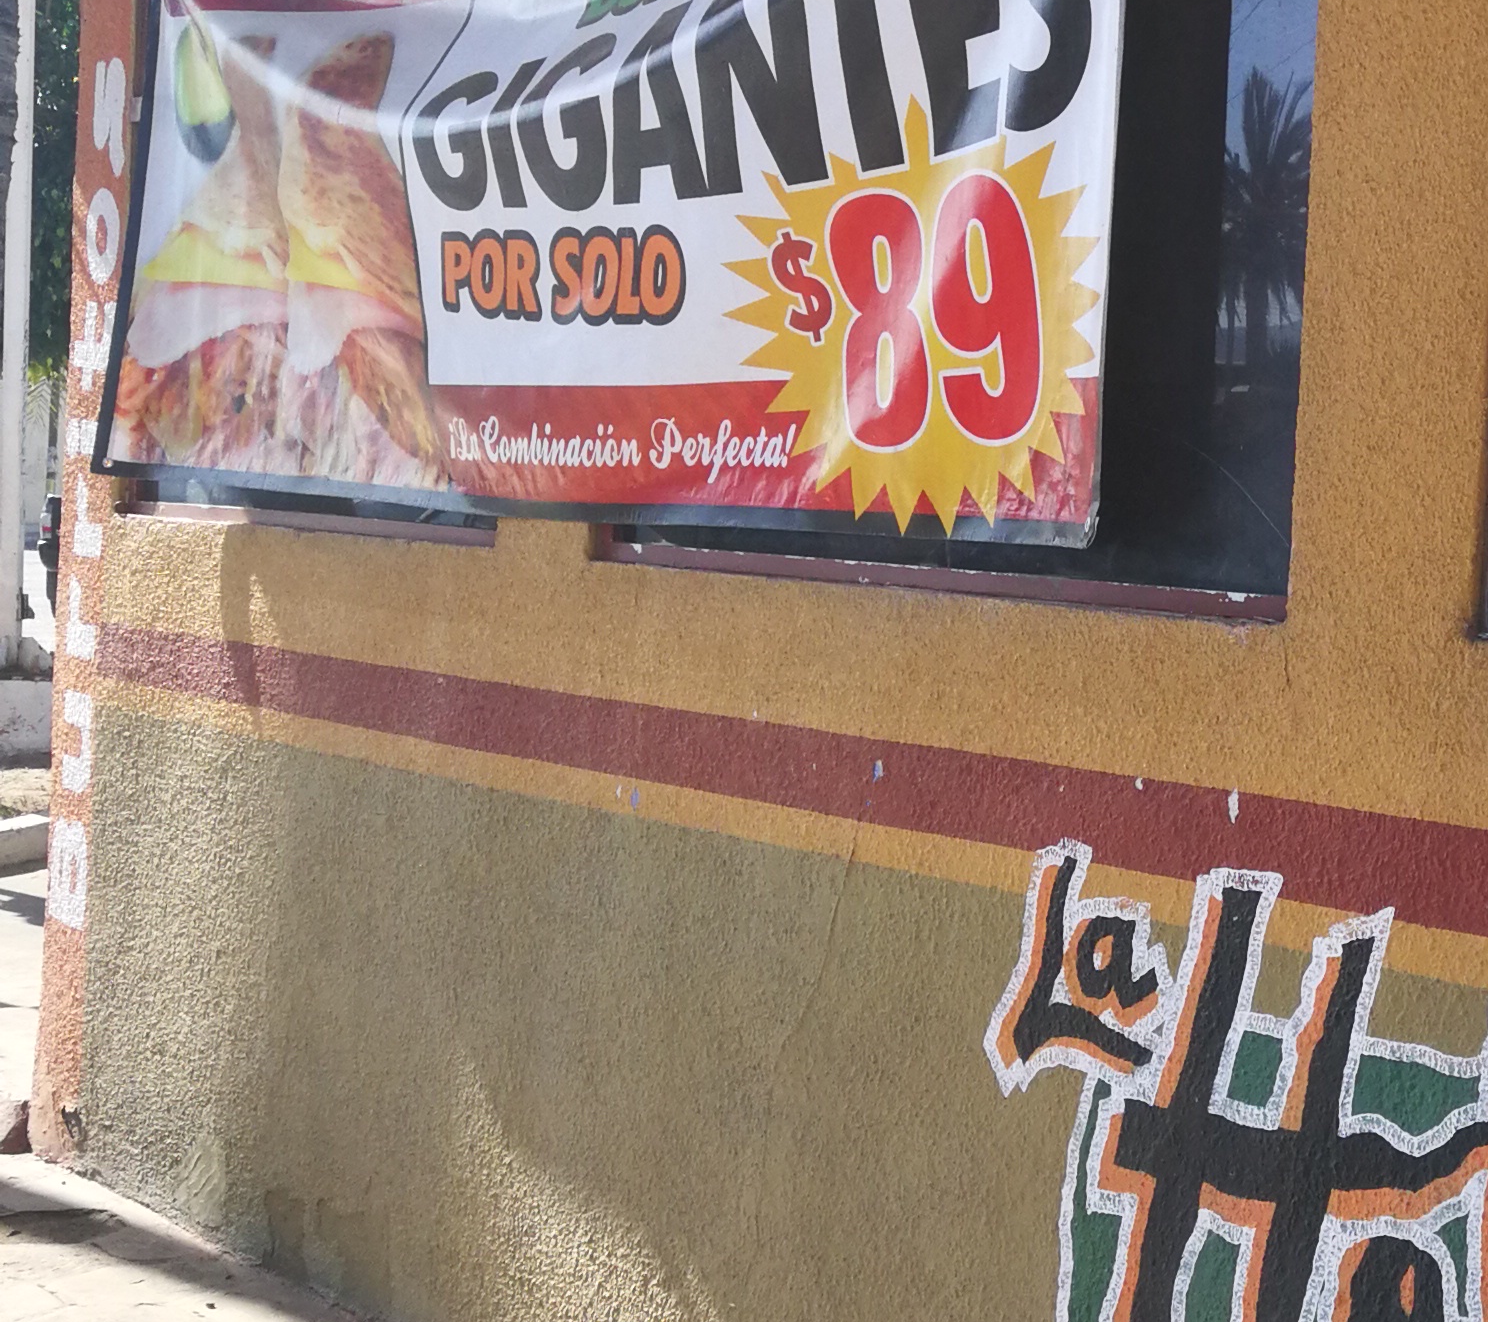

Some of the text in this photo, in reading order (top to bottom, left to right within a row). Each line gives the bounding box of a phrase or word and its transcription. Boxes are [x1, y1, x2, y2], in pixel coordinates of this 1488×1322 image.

[440, 223, 686, 325] POR SOLO
[768, 171, 1044, 453] $89
[47, 57, 127, 931] Burritos
[480, 415, 641, 468] Combinación
[649, 417, 796, 484] Perfecta!
[988, 842, 1165, 1085] La
